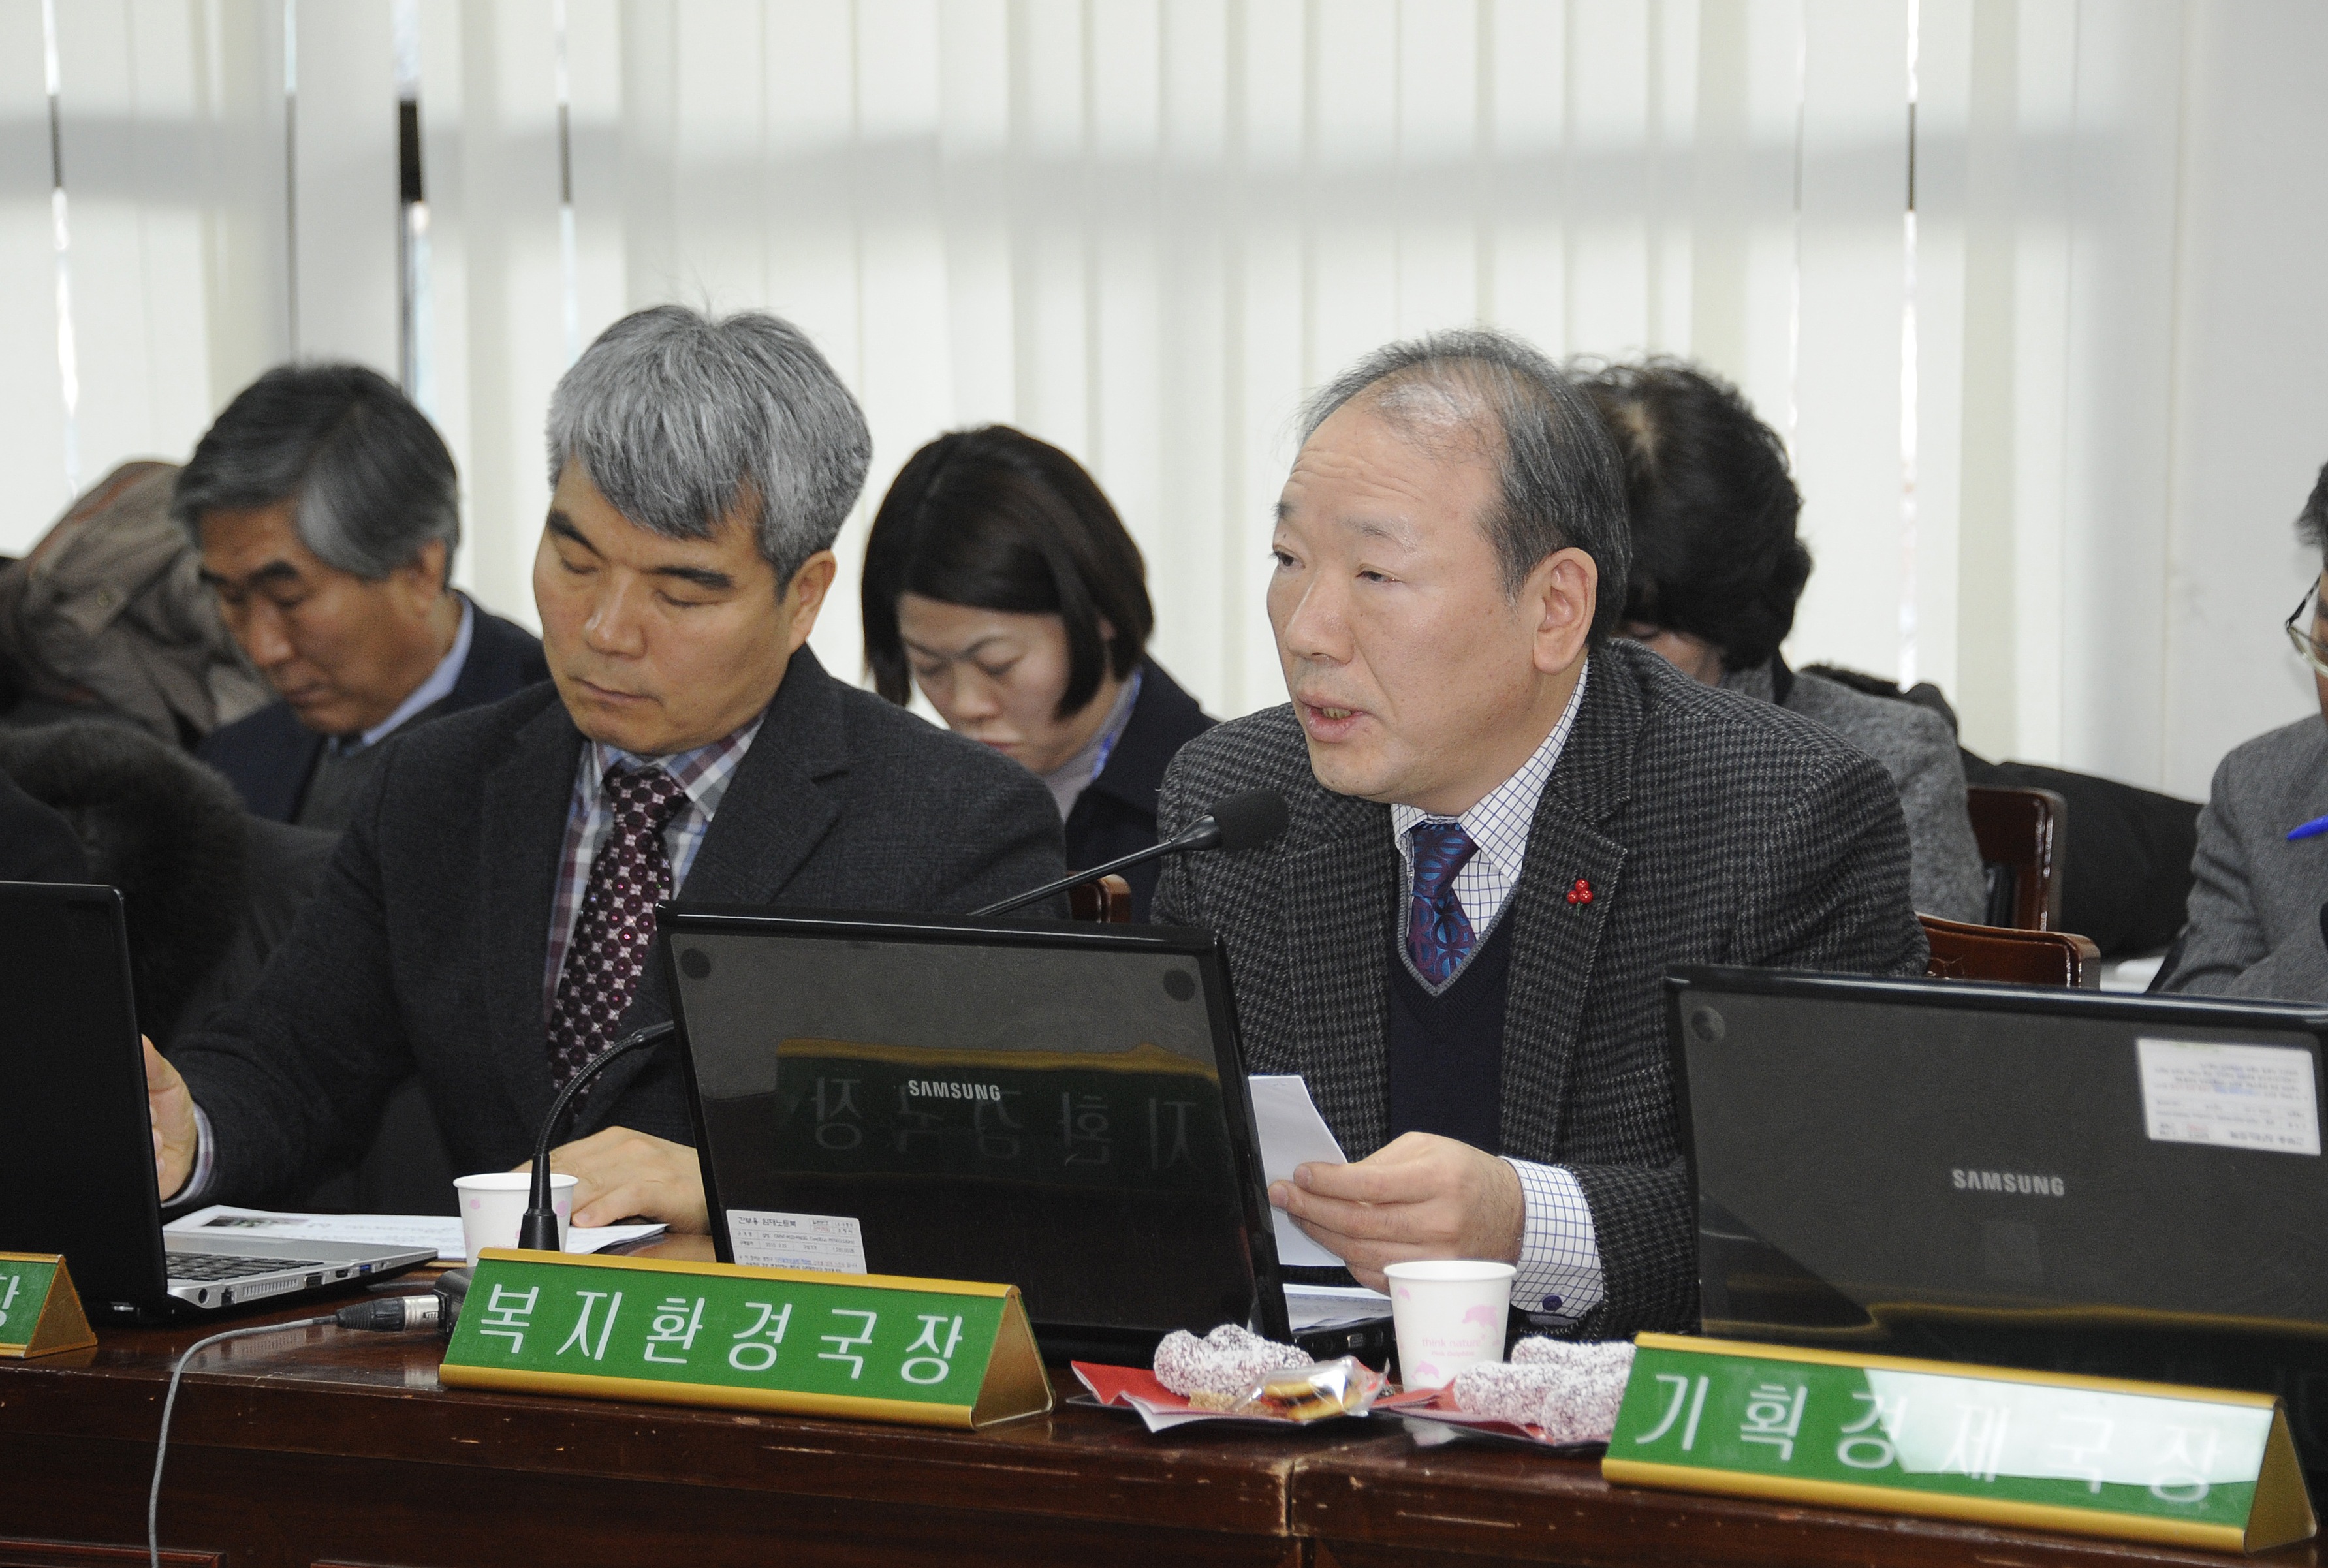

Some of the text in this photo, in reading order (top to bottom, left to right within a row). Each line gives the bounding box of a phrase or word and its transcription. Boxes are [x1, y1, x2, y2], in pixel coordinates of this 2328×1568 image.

[907, 1079, 1001, 1101] SAMSUNG
[1952, 1168, 2065, 1197] SAMSUNG
[479, 1283, 963, 1384] 복지환경국장
[1422, 1337, 1481, 1347] think nature
[1635, 1373, 2223, 1503] 기획경제국장
